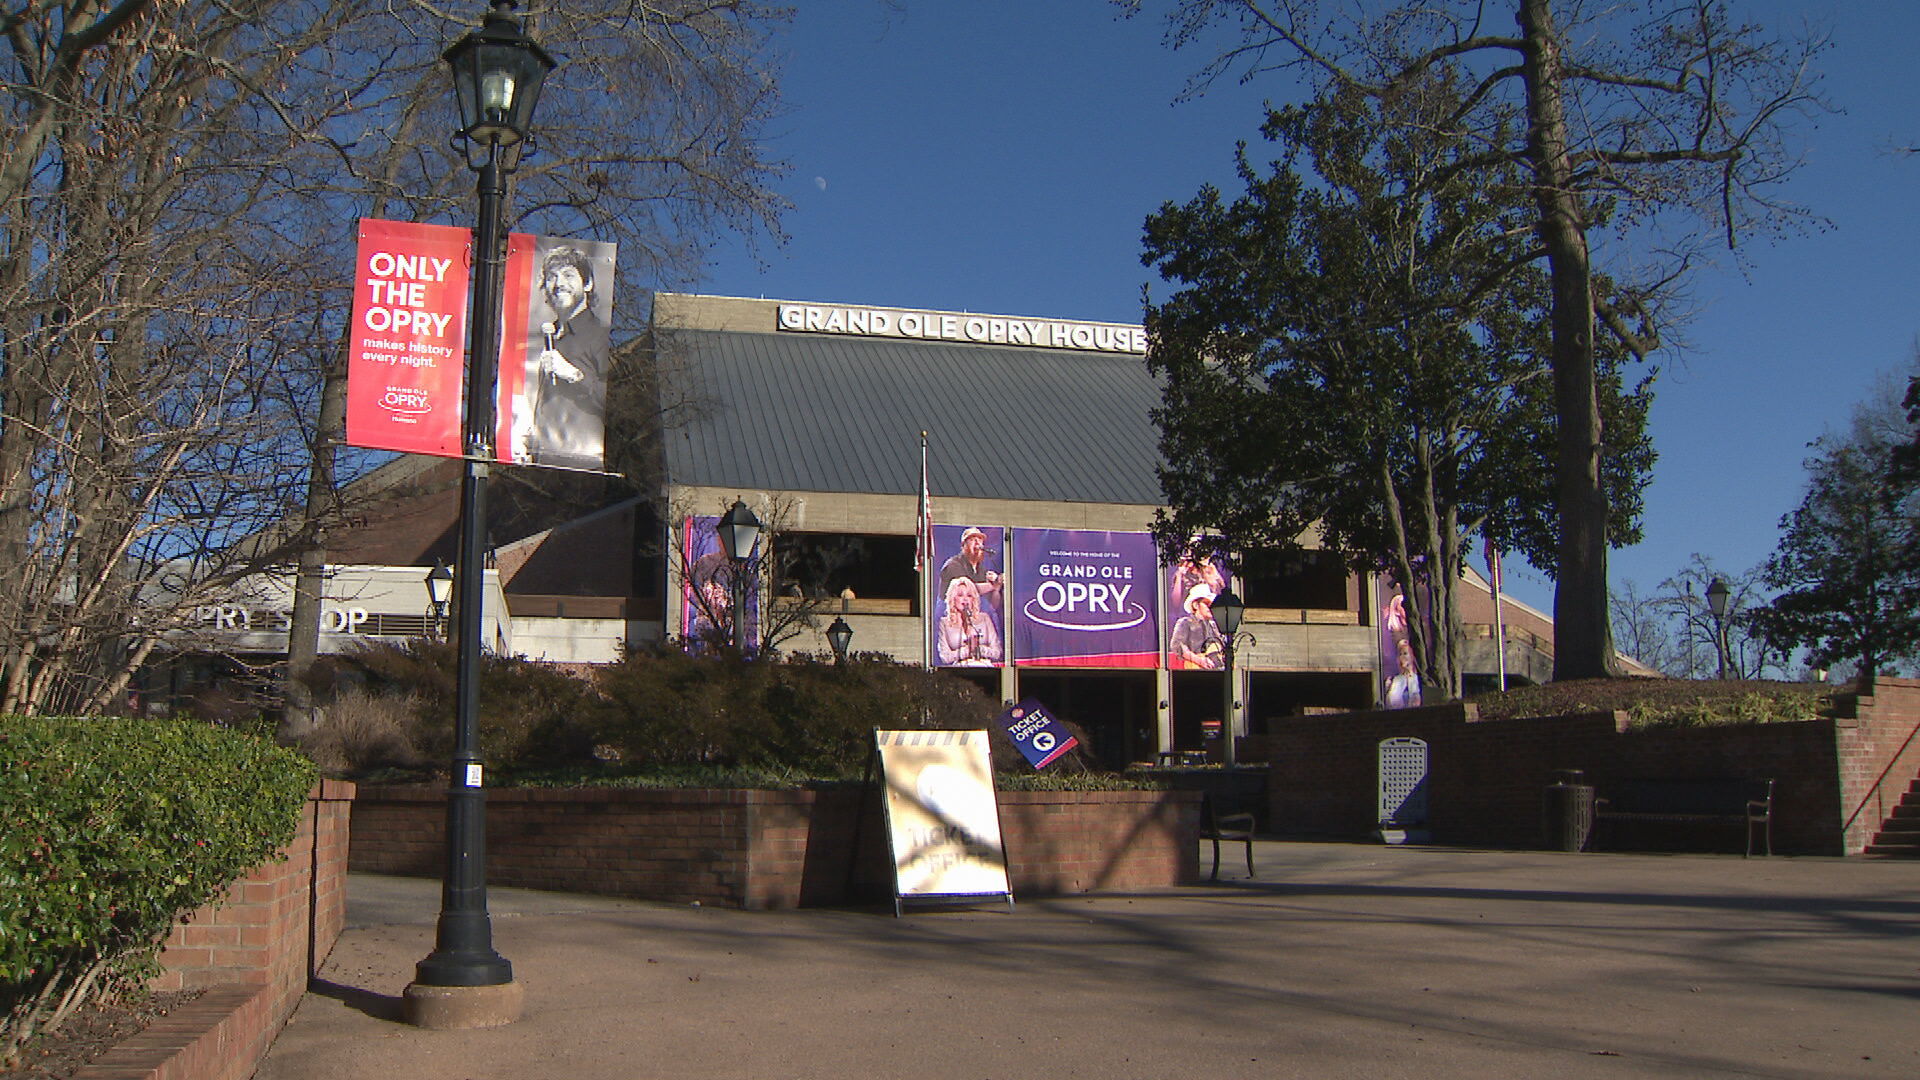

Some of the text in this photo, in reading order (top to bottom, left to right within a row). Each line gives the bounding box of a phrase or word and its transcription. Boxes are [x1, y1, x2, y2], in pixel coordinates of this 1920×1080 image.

[369, 252, 452, 282] ONLY
[367, 278, 426, 308] THE
[365, 307, 452, 337] OPRY
[779, 306, 1148, 352] GRAND OLE OPRY HOUSE
[362, 352, 437, 368] every night.
[363, 338, 454, 357] makes history
[385, 392, 428, 408] OPRY
[1039, 564, 1133, 579] GRAND OLE
[1036, 580, 1132, 614] OPRY
[274, 607, 368, 633] SOP
[1008, 709, 1043, 735] TICKET
[1016, 715, 1052, 741] OFFICE
